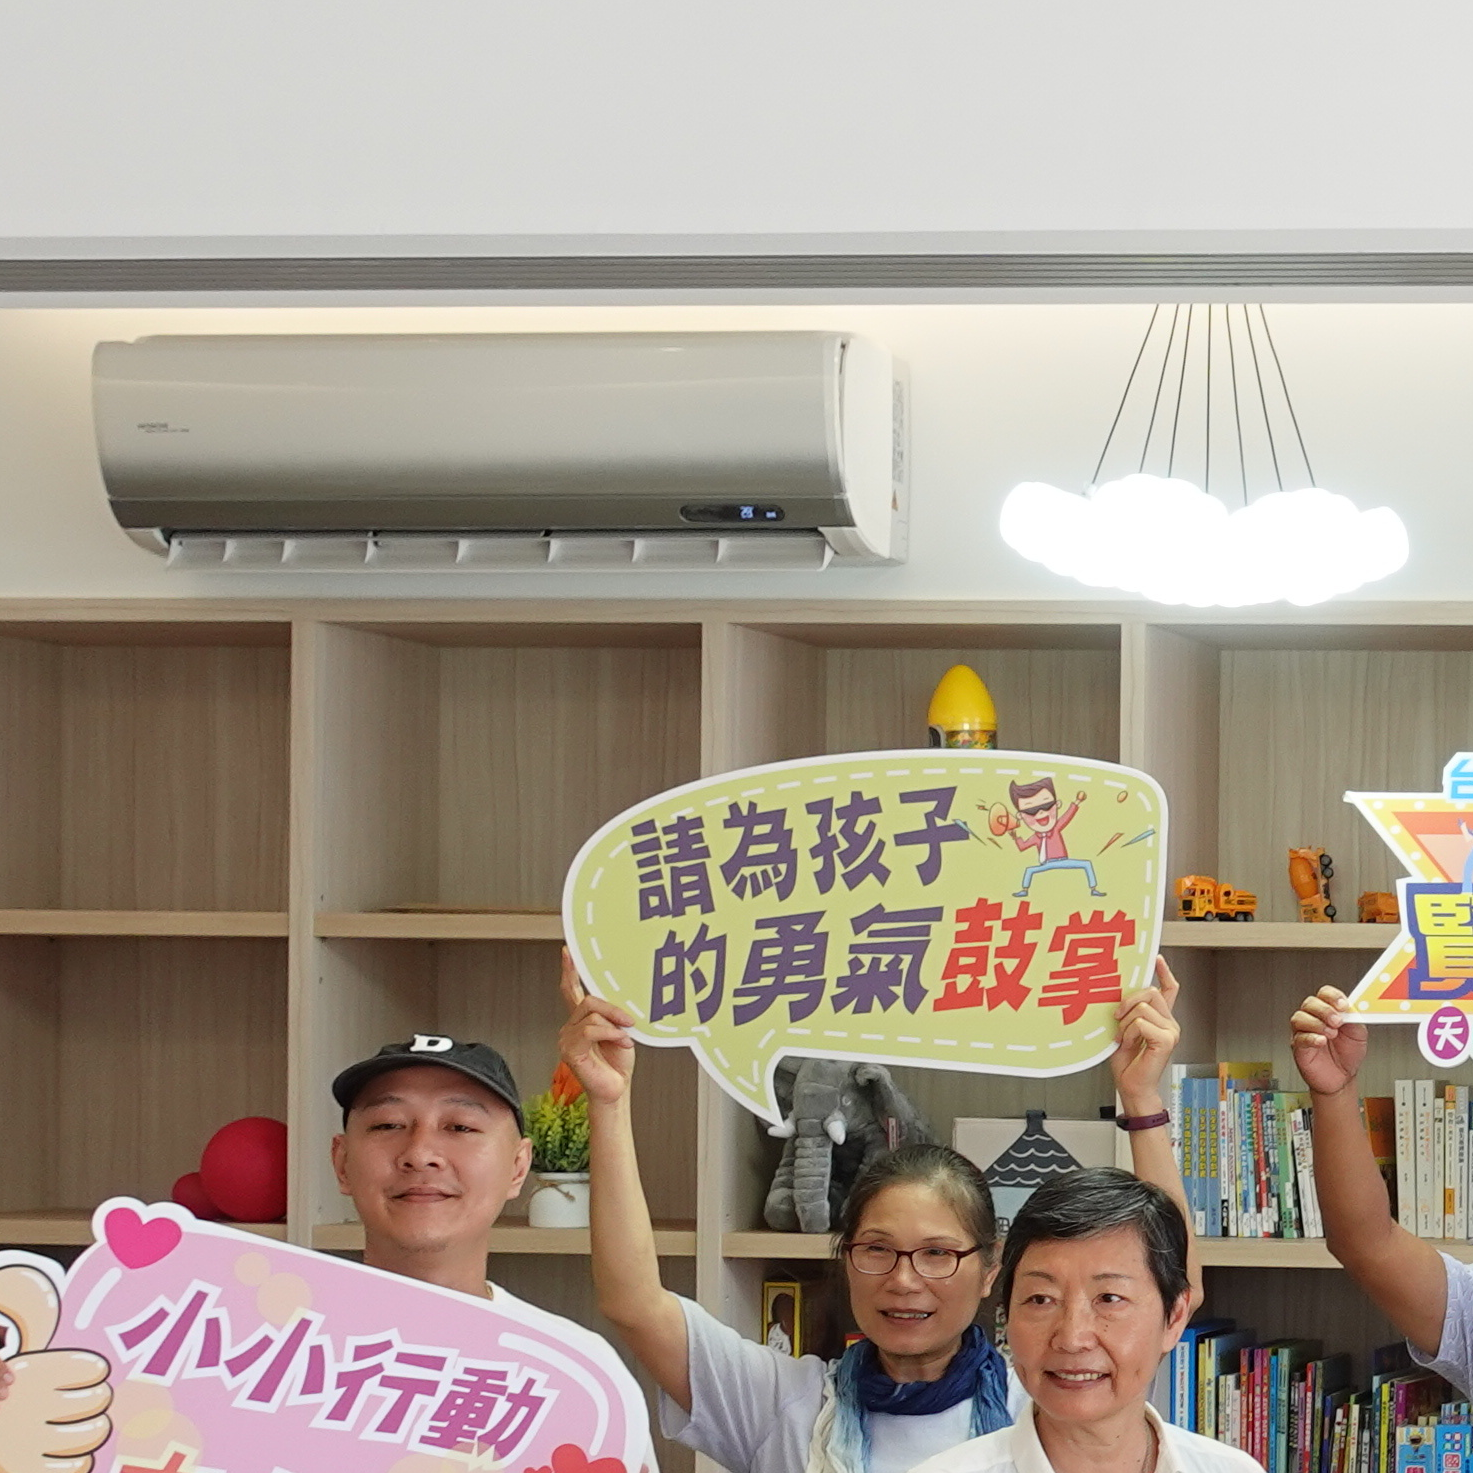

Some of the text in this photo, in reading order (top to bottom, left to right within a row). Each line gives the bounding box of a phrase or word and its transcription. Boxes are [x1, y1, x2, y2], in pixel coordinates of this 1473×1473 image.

[631, 787, 970, 920] 請為孩子
[650, 898, 1136, 1026] 的勇氣鼓掌
[120, 1290, 546, 1460] 小小行動
